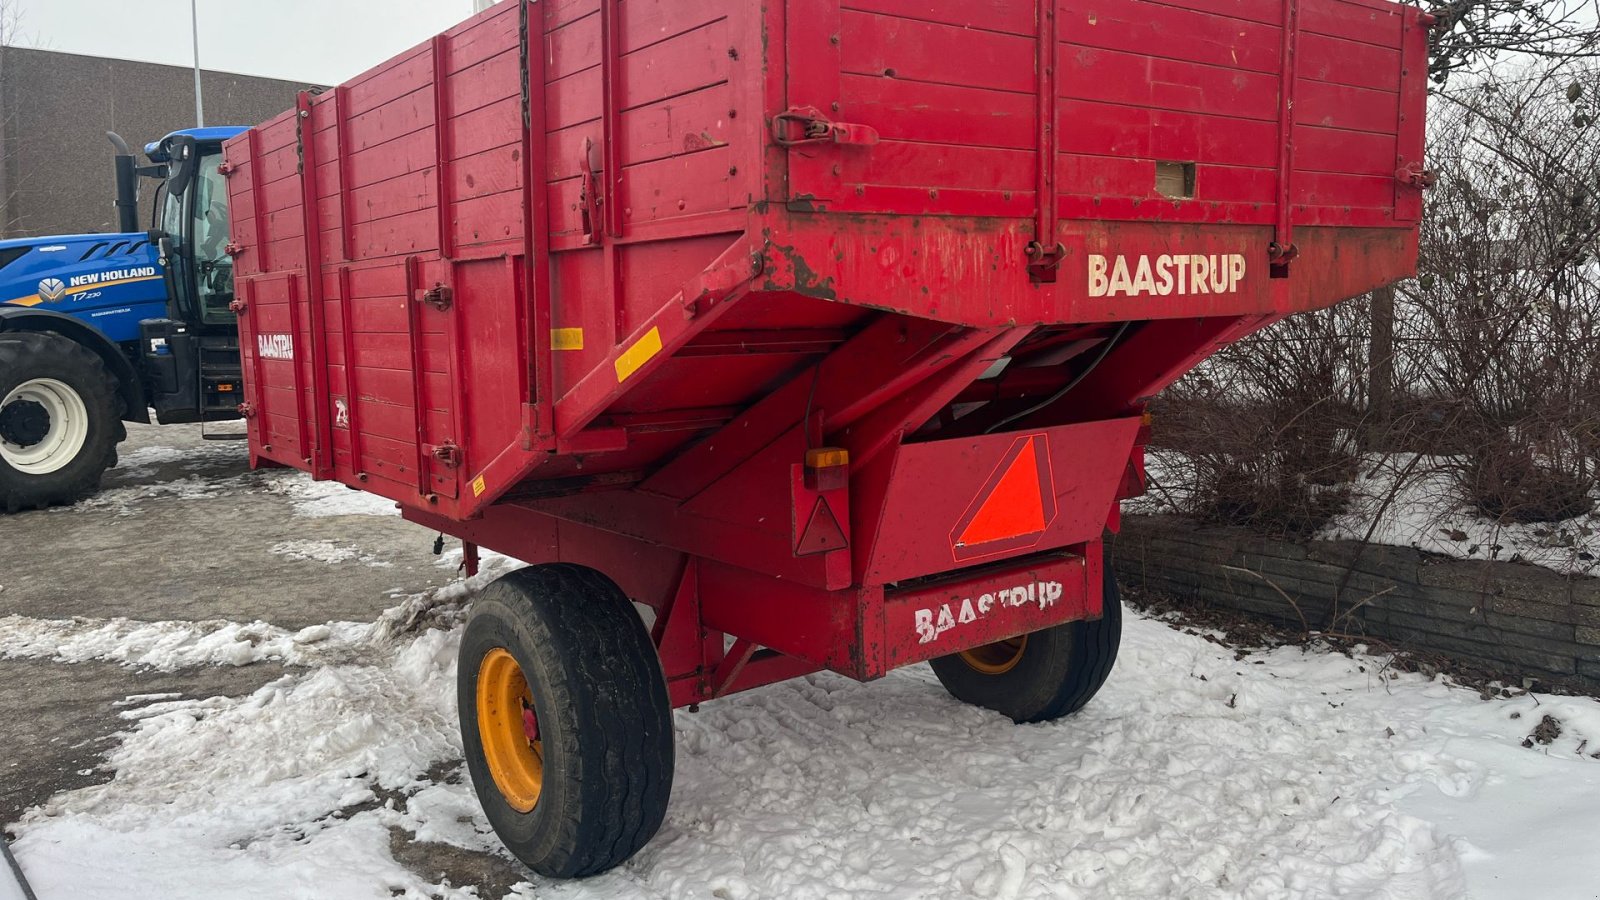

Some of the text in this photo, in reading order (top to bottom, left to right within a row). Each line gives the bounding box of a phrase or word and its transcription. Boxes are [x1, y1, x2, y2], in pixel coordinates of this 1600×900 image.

[70, 266, 155, 287] NEW HOLLAND
[1088, 254, 1246, 296] BAASTRUP
